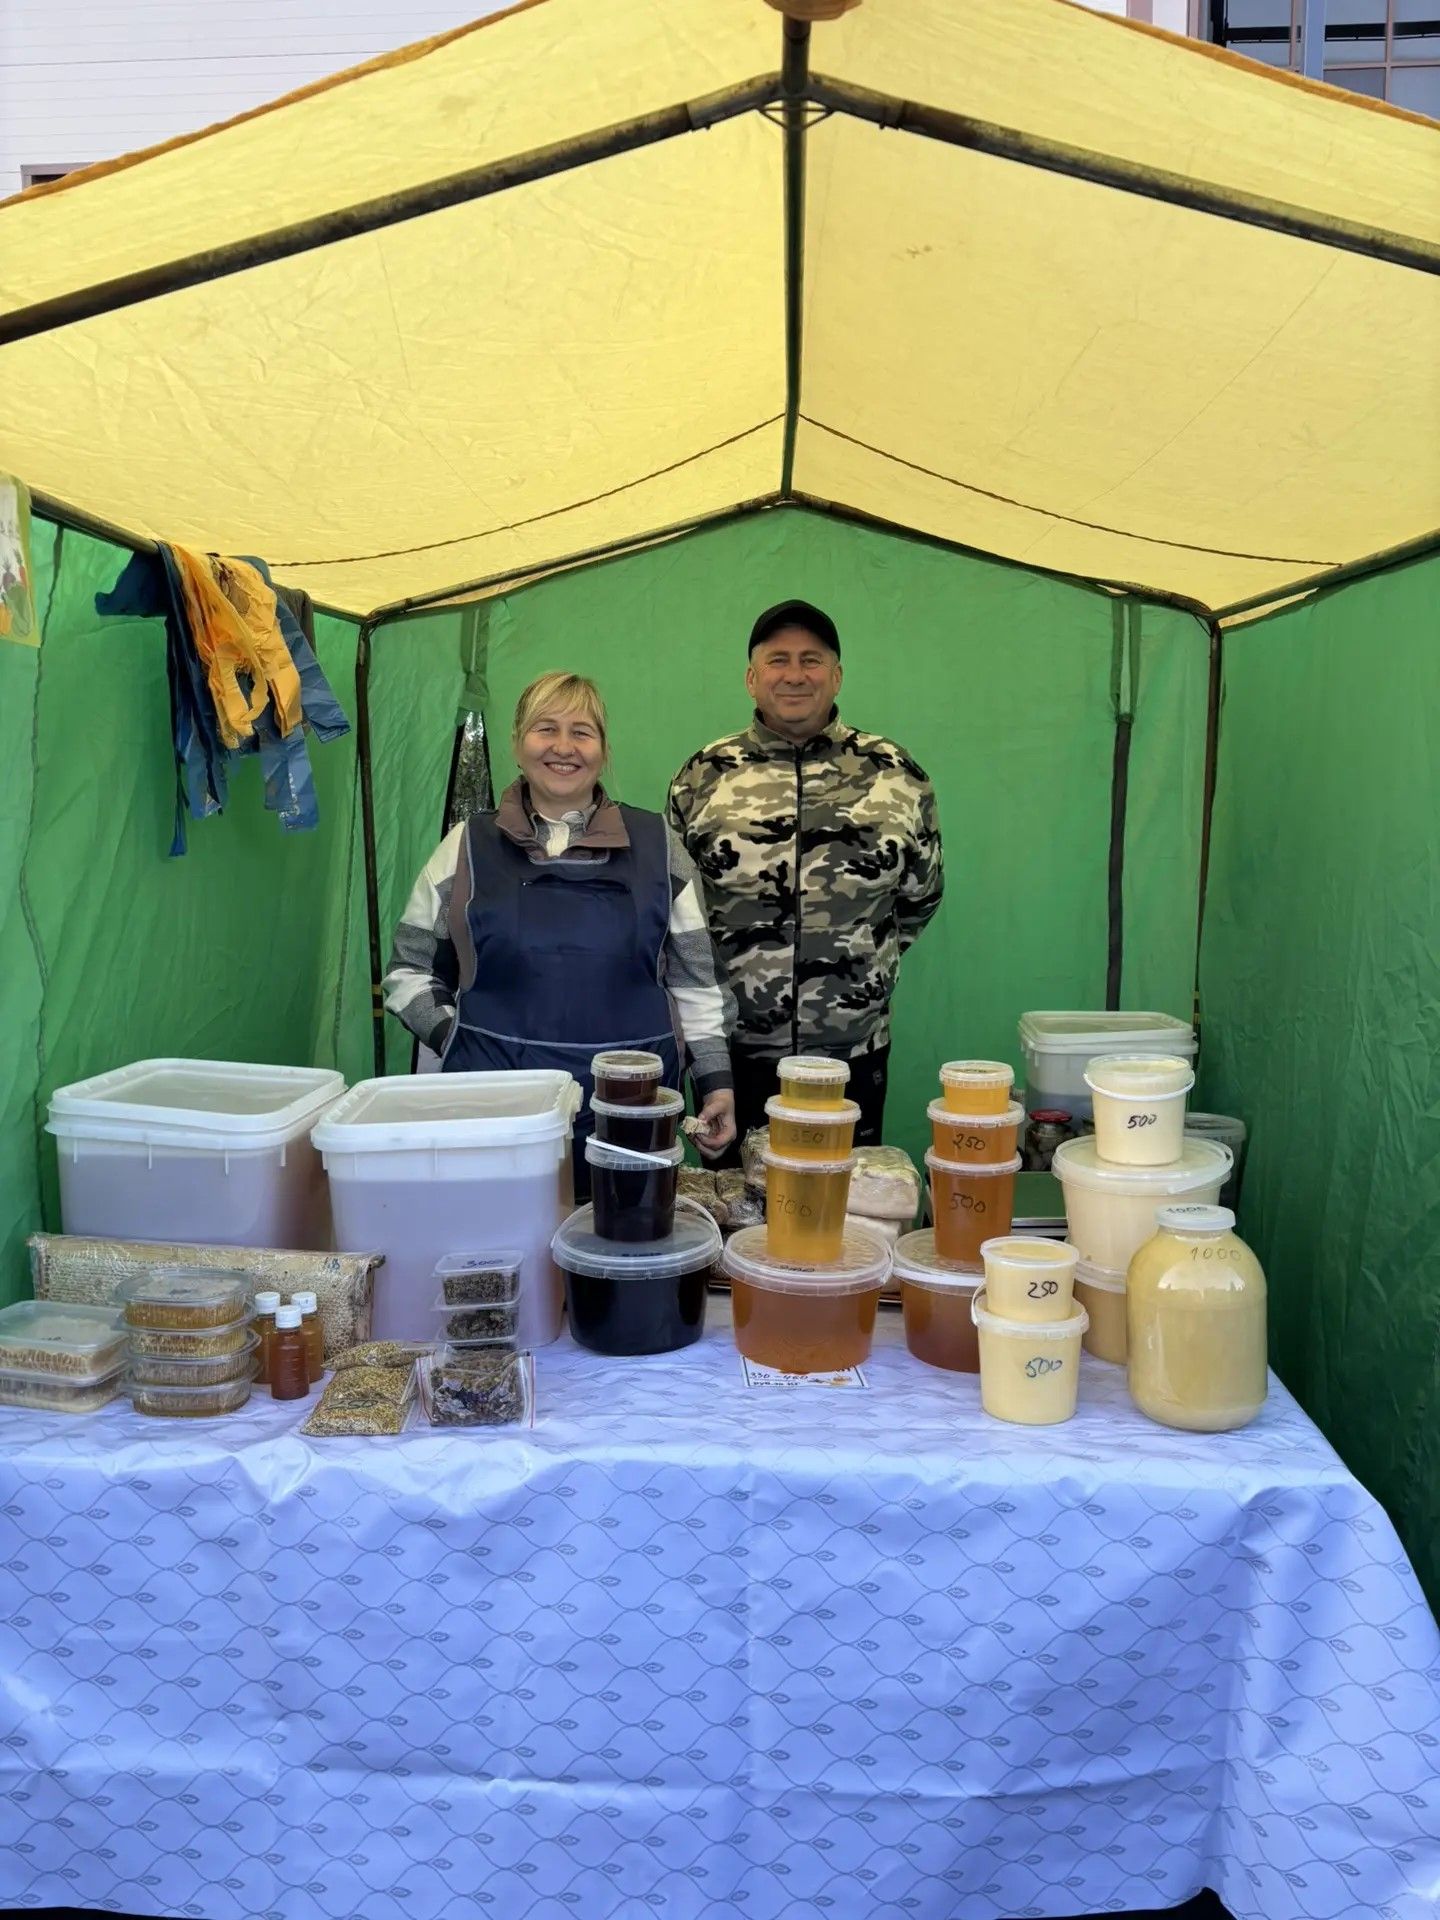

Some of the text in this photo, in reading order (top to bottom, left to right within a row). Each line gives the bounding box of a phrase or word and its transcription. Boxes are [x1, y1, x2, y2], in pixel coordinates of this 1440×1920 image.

[1127, 1114, 1158, 1129] 500
[791, 1129, 824, 1144] 350
[952, 1133, 986, 1151] 250
[776, 1194, 812, 1217] 700
[950, 1192, 986, 1214] 500
[1191, 1247, 1241, 1260] 1000
[1027, 1281, 1058, 1299] 250
[1025, 1357, 1063, 1378] 500
